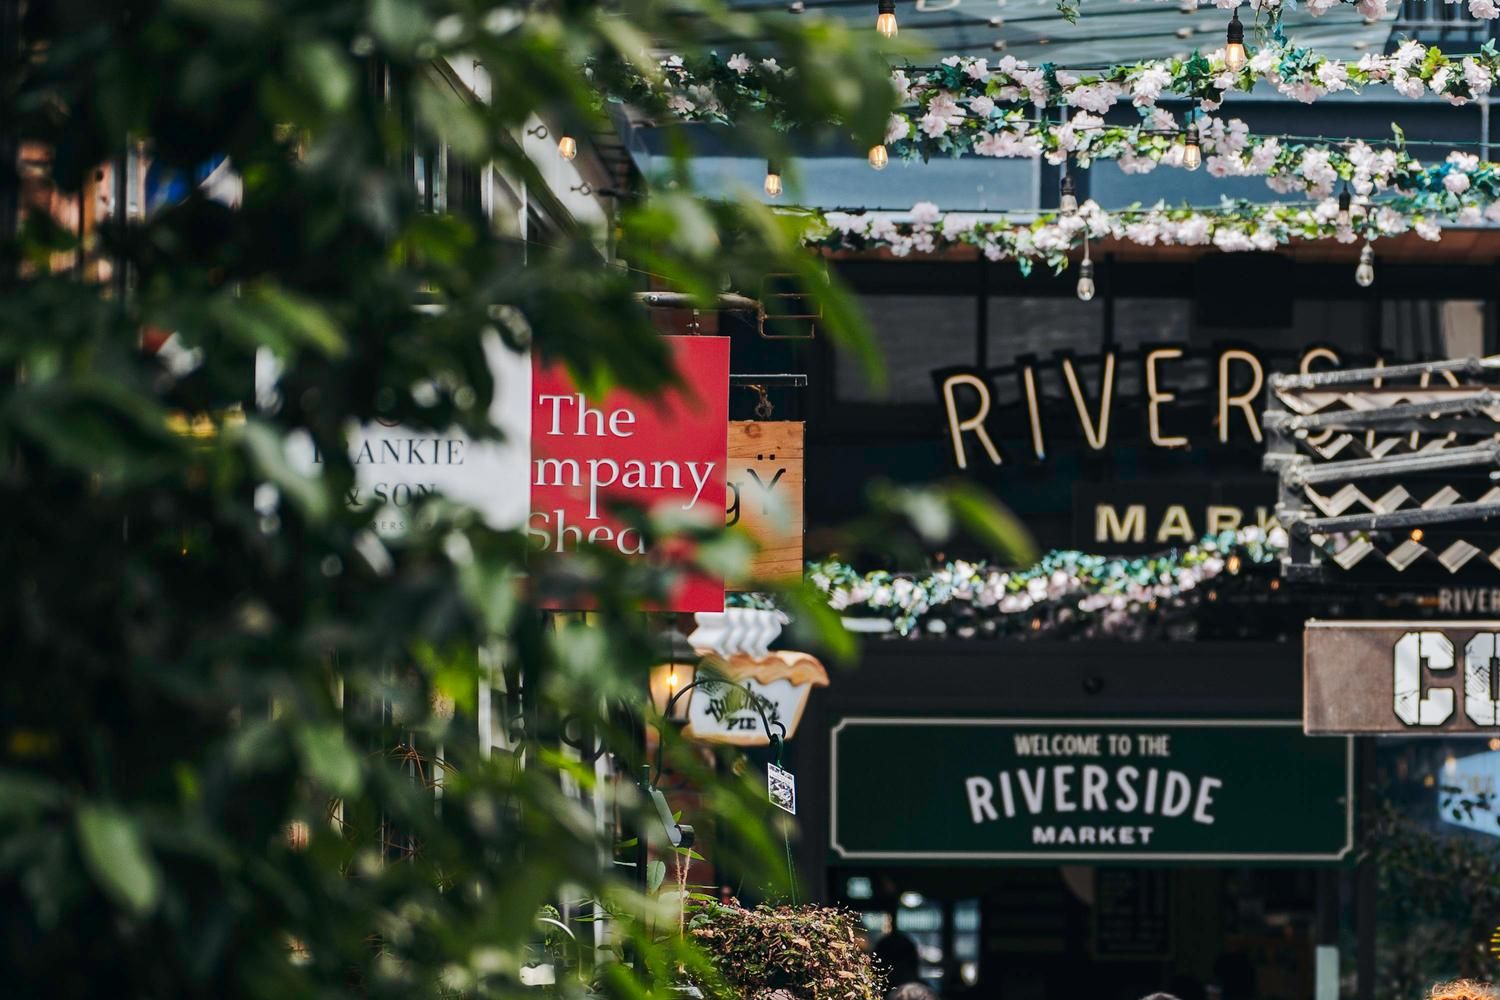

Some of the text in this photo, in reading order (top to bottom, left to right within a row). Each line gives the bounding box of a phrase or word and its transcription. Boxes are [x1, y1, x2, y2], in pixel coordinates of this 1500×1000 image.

[538, 392, 637, 438] The
[1014, 734, 1171, 757] WELCOME TO THE
[965, 764, 1223, 825] RIVERSIDE
[1032, 825, 1154, 845] MARKET
